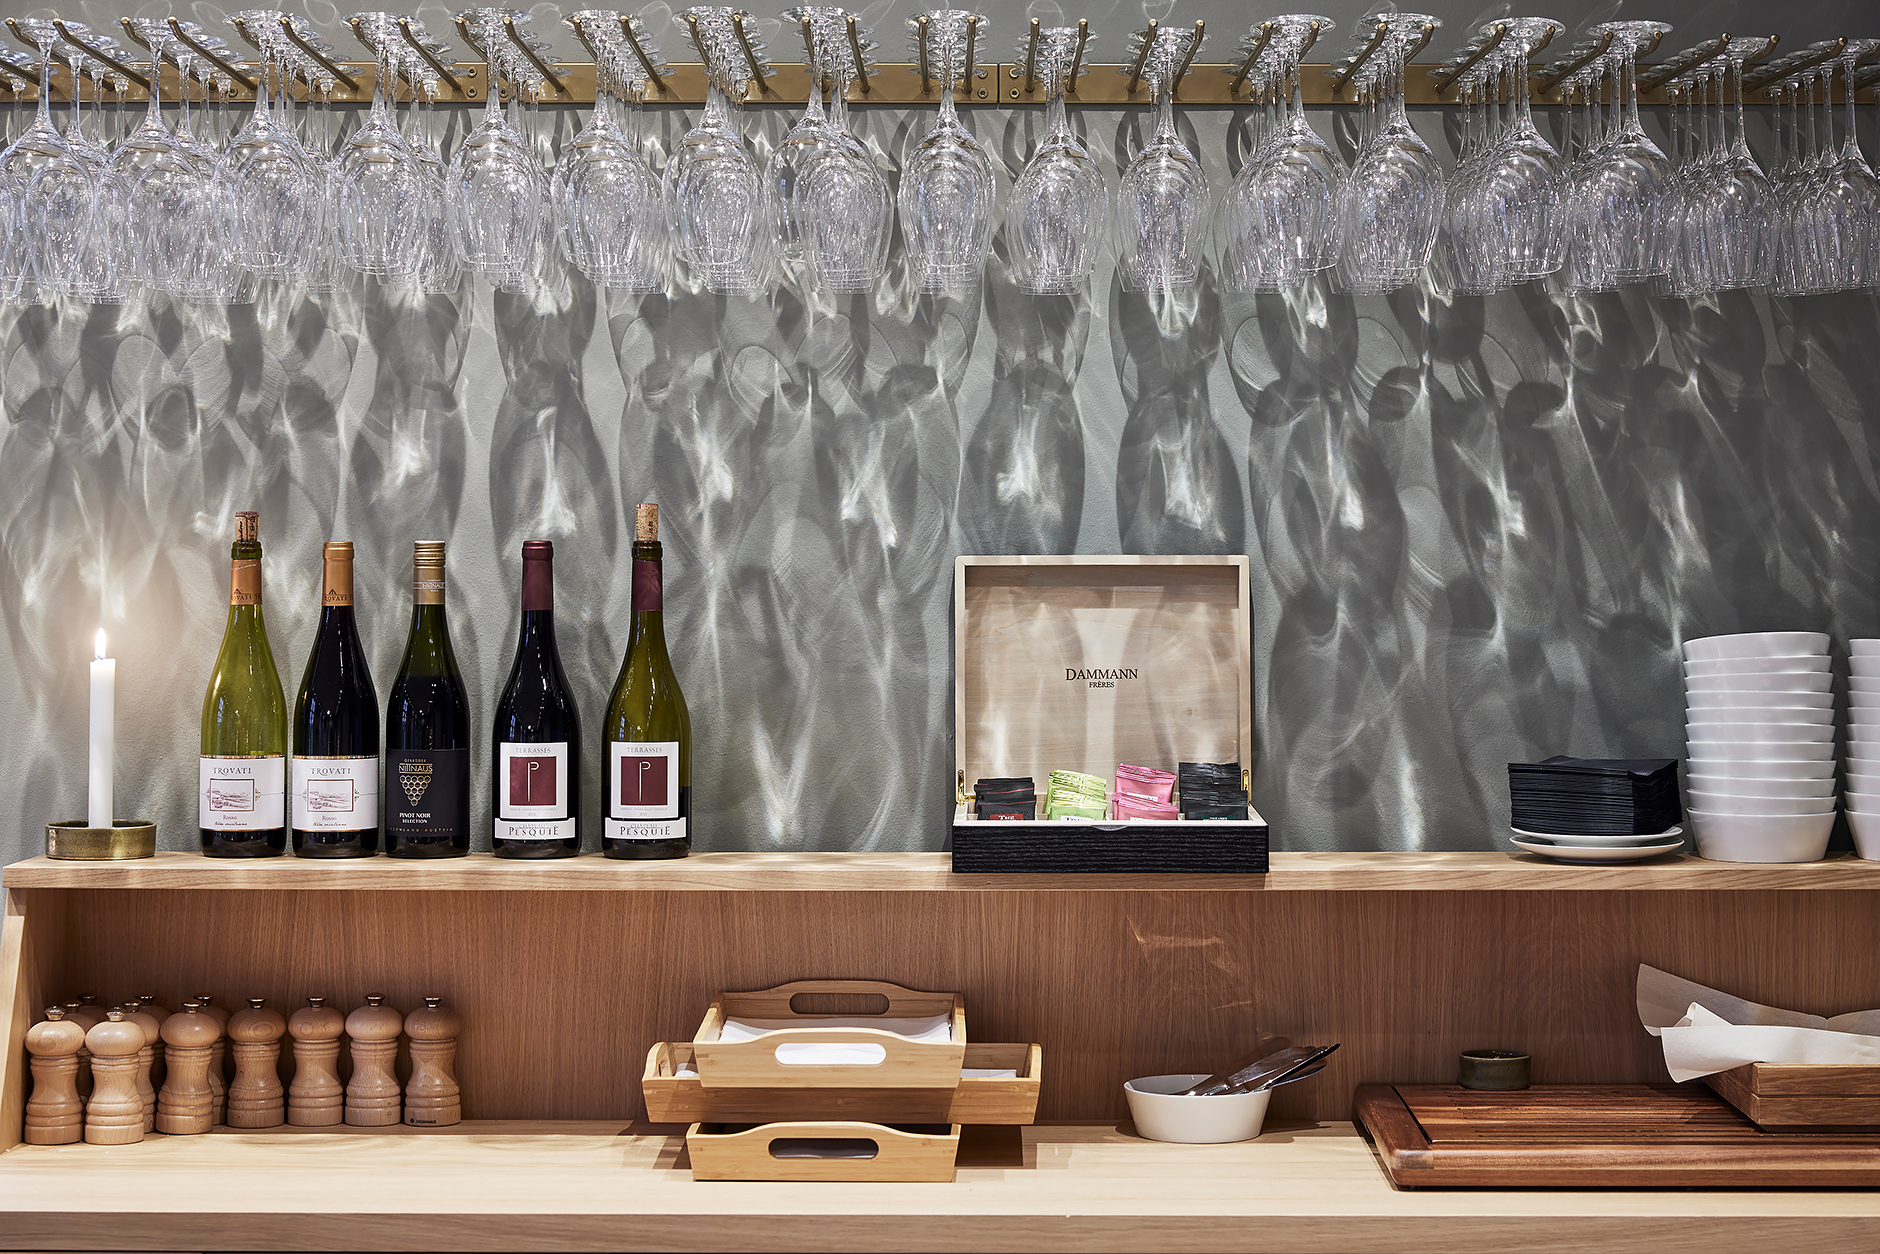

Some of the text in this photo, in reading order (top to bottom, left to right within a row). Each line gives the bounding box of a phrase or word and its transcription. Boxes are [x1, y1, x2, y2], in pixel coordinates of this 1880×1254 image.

[1065, 668, 1138, 681] DAMMANN
[212, 767, 252, 776] TROVATI
[310, 767, 352, 776] TROVATI
[527, 761, 540, 803] P
[639, 761, 651, 802] P
